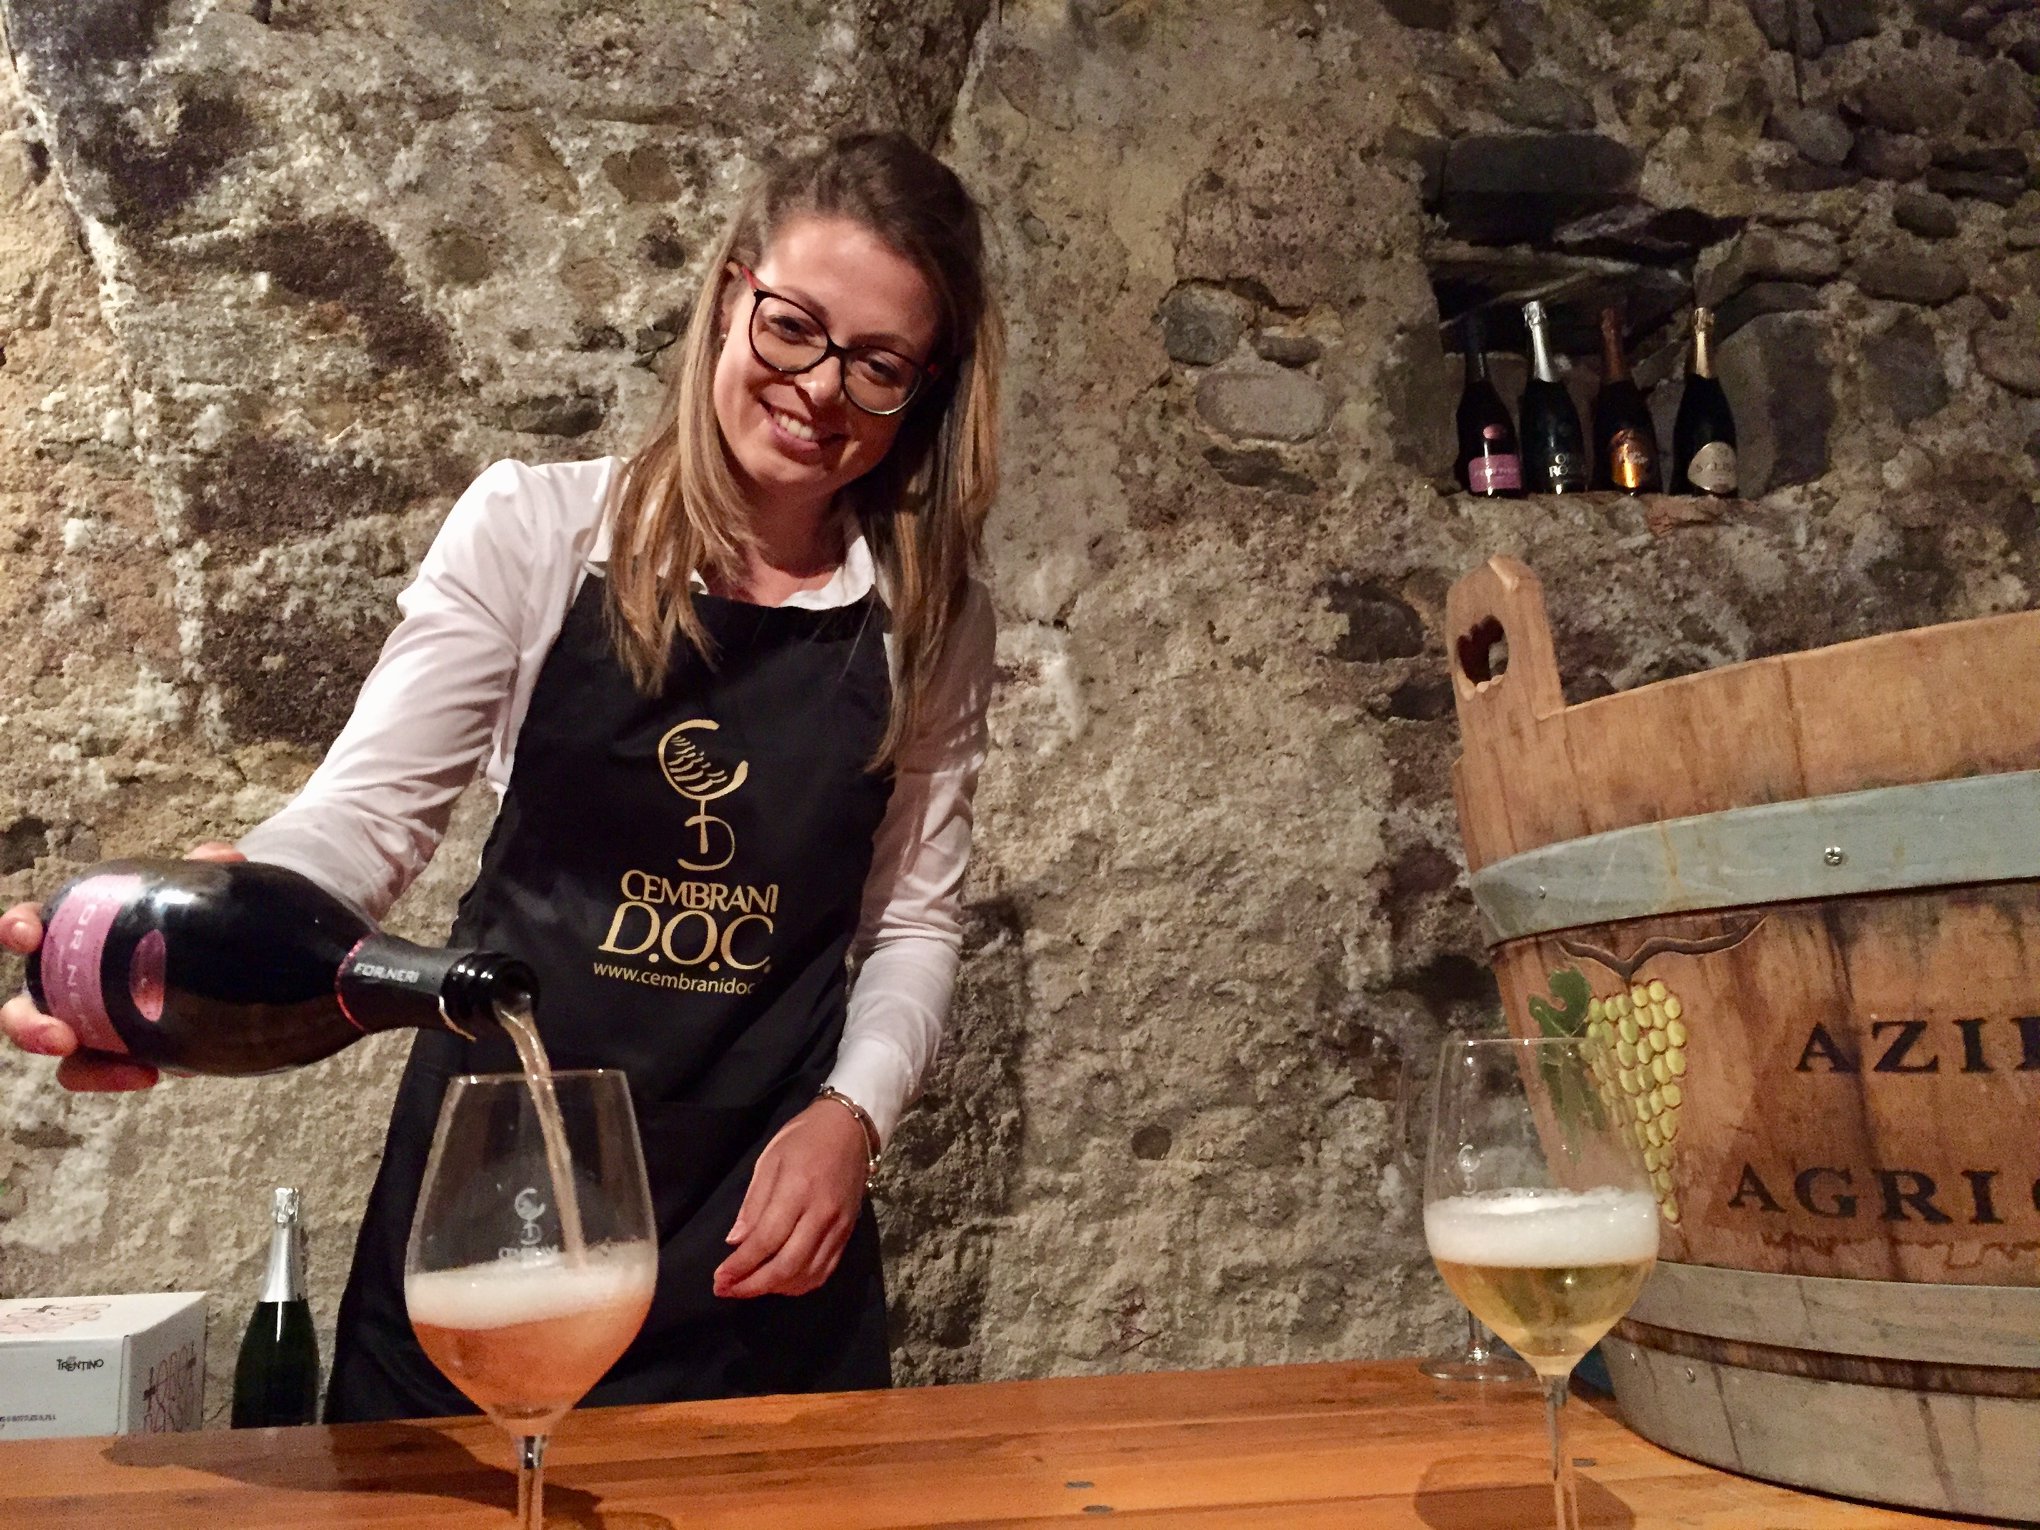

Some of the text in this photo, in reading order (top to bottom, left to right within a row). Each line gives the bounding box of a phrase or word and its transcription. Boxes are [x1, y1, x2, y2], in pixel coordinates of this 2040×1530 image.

[620, 869, 779, 913] CEMBRANI
[1728, 1163, 2040, 1225] AGRI
[56, 1358, 105, 1372] TRENTINO
